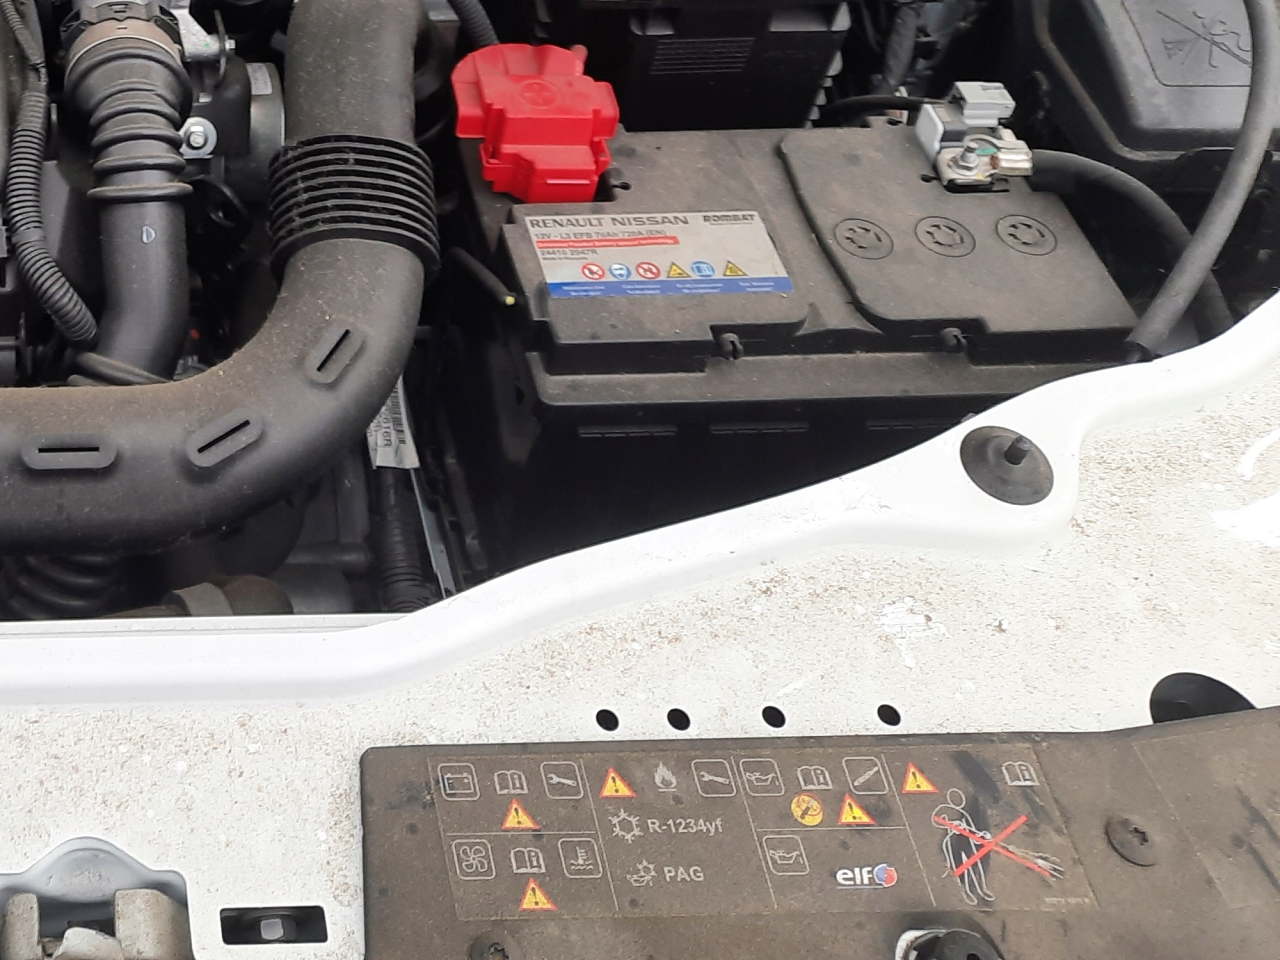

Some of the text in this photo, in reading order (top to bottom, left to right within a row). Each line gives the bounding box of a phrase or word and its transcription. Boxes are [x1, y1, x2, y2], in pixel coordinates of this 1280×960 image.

[529, 215, 689, 229] RENAULT NISSAN
[703, 214, 756, 223] ROMBAT
[534, 232, 552, 240] 12V
[573, 231, 594, 240] EFB
[647, 817, 723, 836] R-1234yf
[663, 866, 705, 882] PAG
